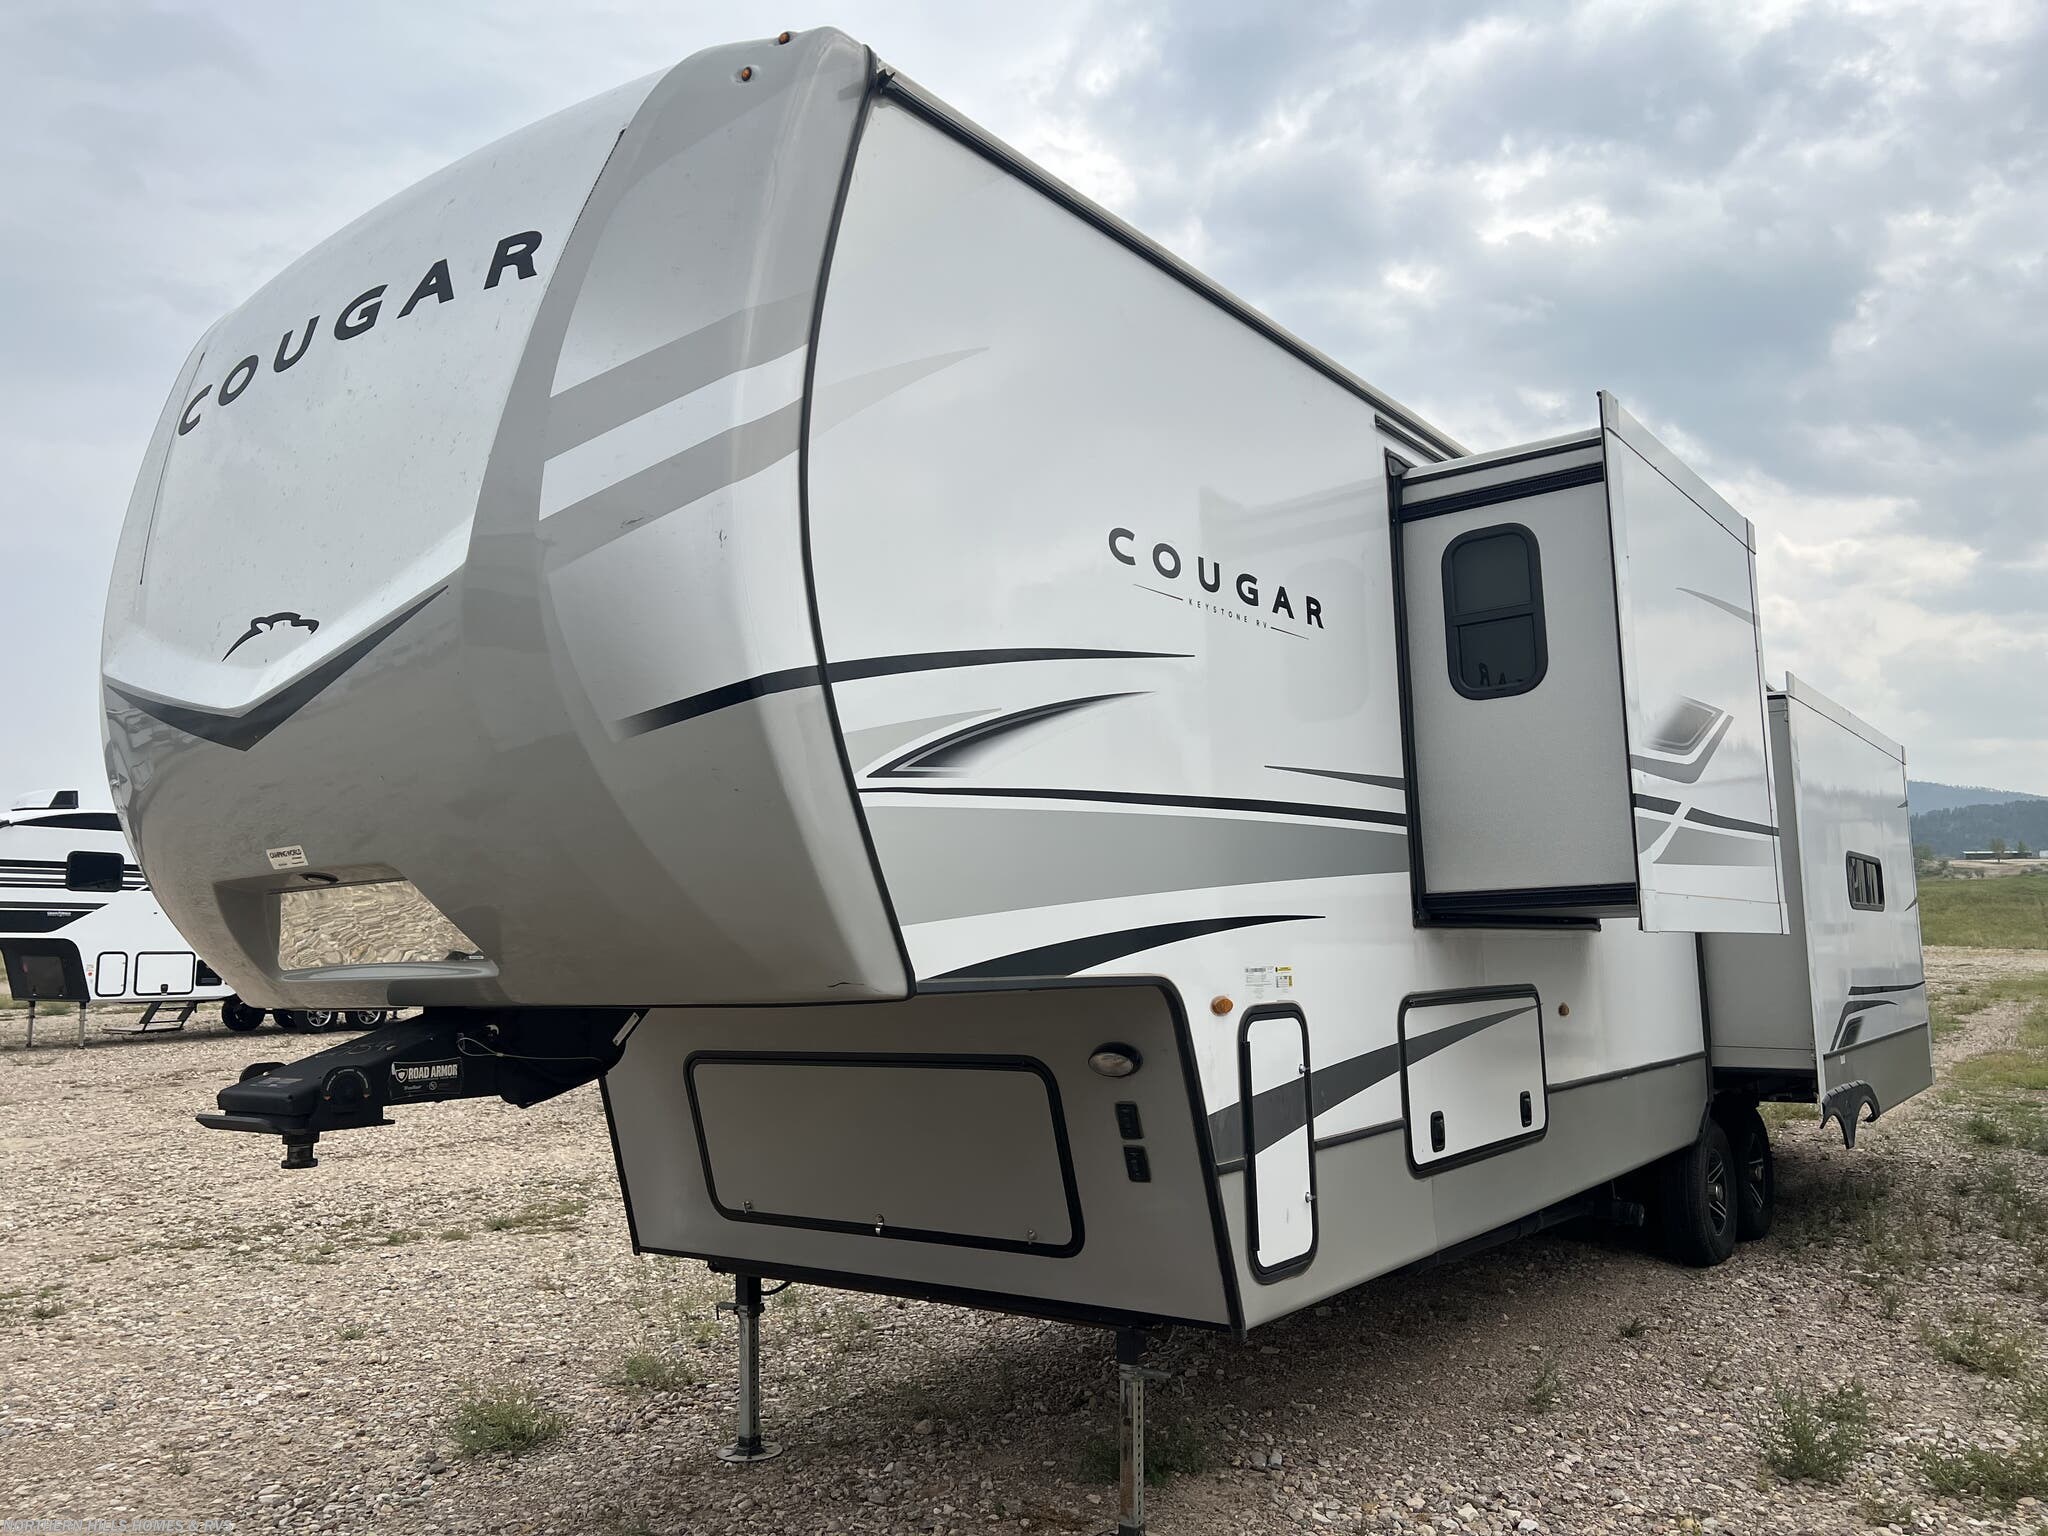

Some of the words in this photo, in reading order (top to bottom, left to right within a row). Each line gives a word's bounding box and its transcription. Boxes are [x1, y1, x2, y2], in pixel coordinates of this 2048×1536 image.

[178, 231, 542, 436] COUGAR
[1108, 527, 1324, 629] COUGAR
[1188, 598, 1248, 623] KEYSTONE
[1256, 619, 1267, 629] RV
[408, 1066, 430, 1080] ROAD
[430, 1064, 458, 1078] ARMOR
